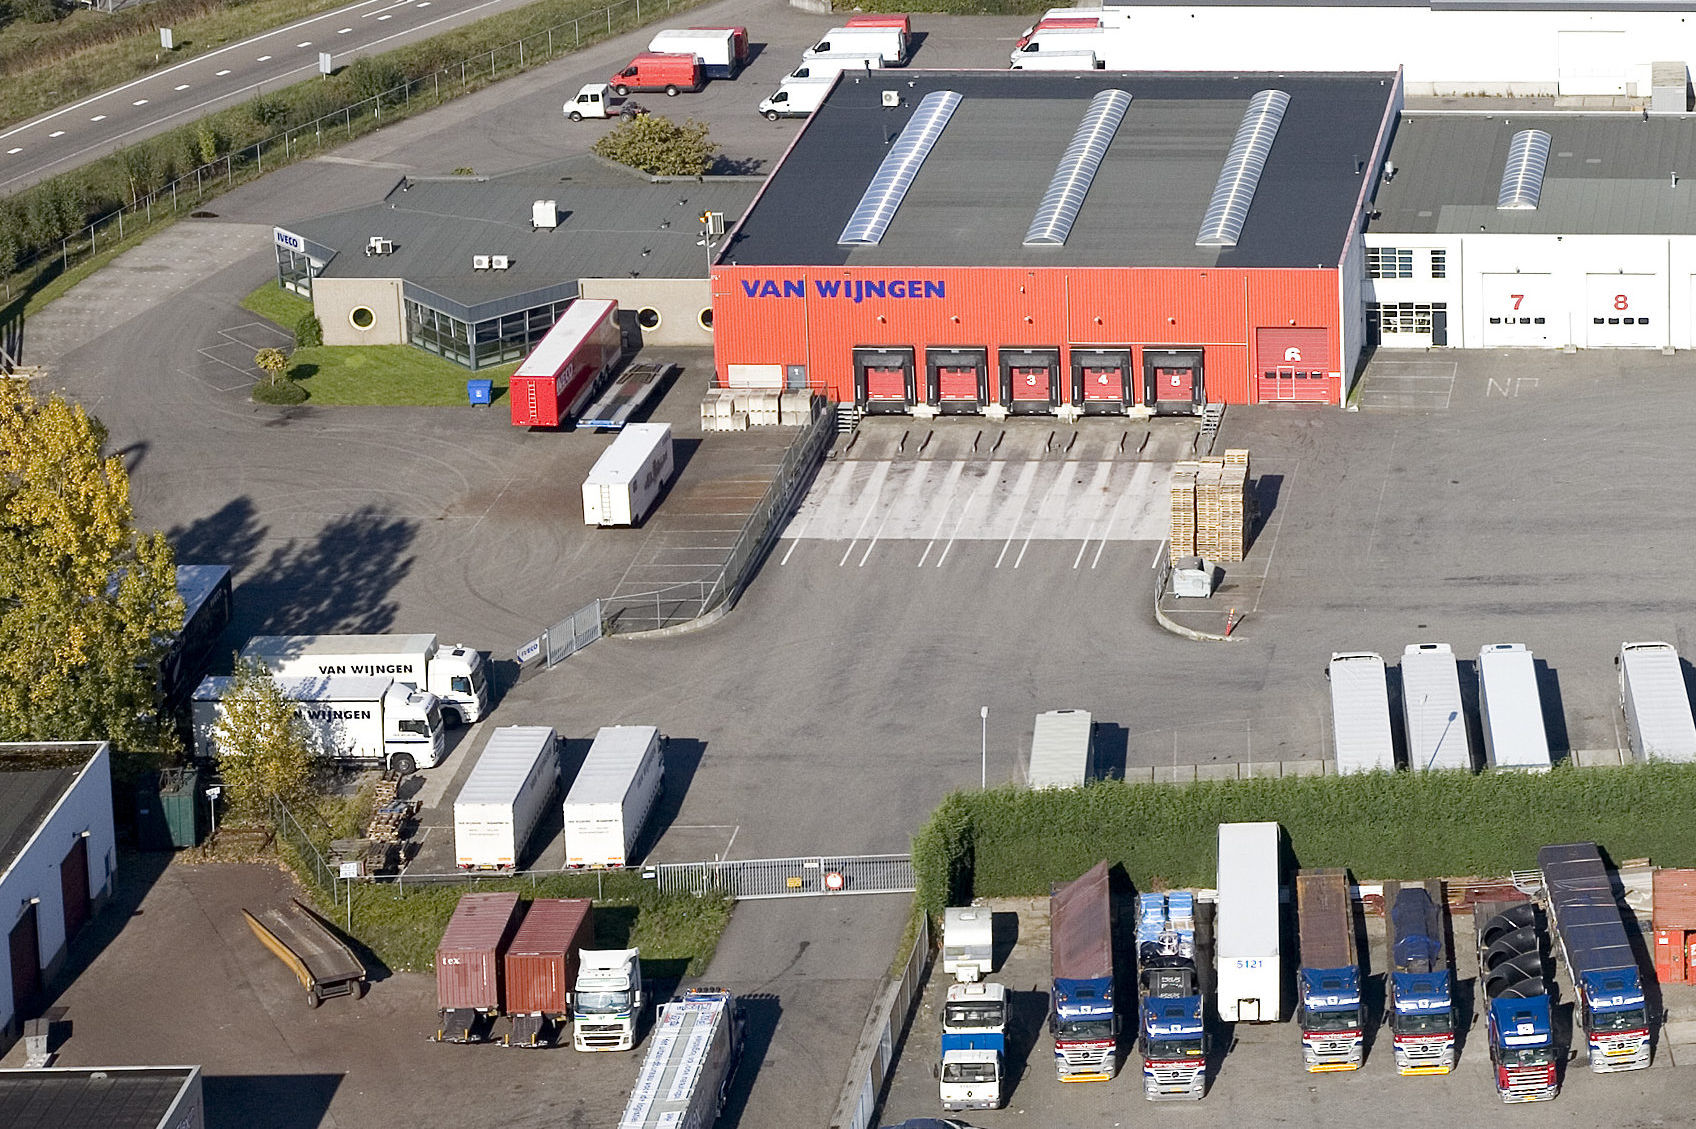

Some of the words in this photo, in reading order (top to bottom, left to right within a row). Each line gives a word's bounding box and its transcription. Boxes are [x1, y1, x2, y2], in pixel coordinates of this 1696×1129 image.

[276, 232, 298, 248] IVECO
[741, 279, 805, 299] VAN
[815, 279, 947, 304] WIJNGEN
[1510, 294, 1525, 311] 7
[1613, 294, 1629, 311] 8
[556, 363, 574, 396] IVECO
[1026, 374, 1037, 387] 3
[1098, 374, 1109, 386] 4
[1170, 375, 1181, 388] 5
[521, 643, 538, 656] IVECO
[318, 665, 346, 675] VAN
[351, 664, 414, 677] WIJNGEN
[308, 710, 371, 722] WIJNGEN
[442, 957, 461, 966] tex
[1236, 960, 1263, 969] 5121
